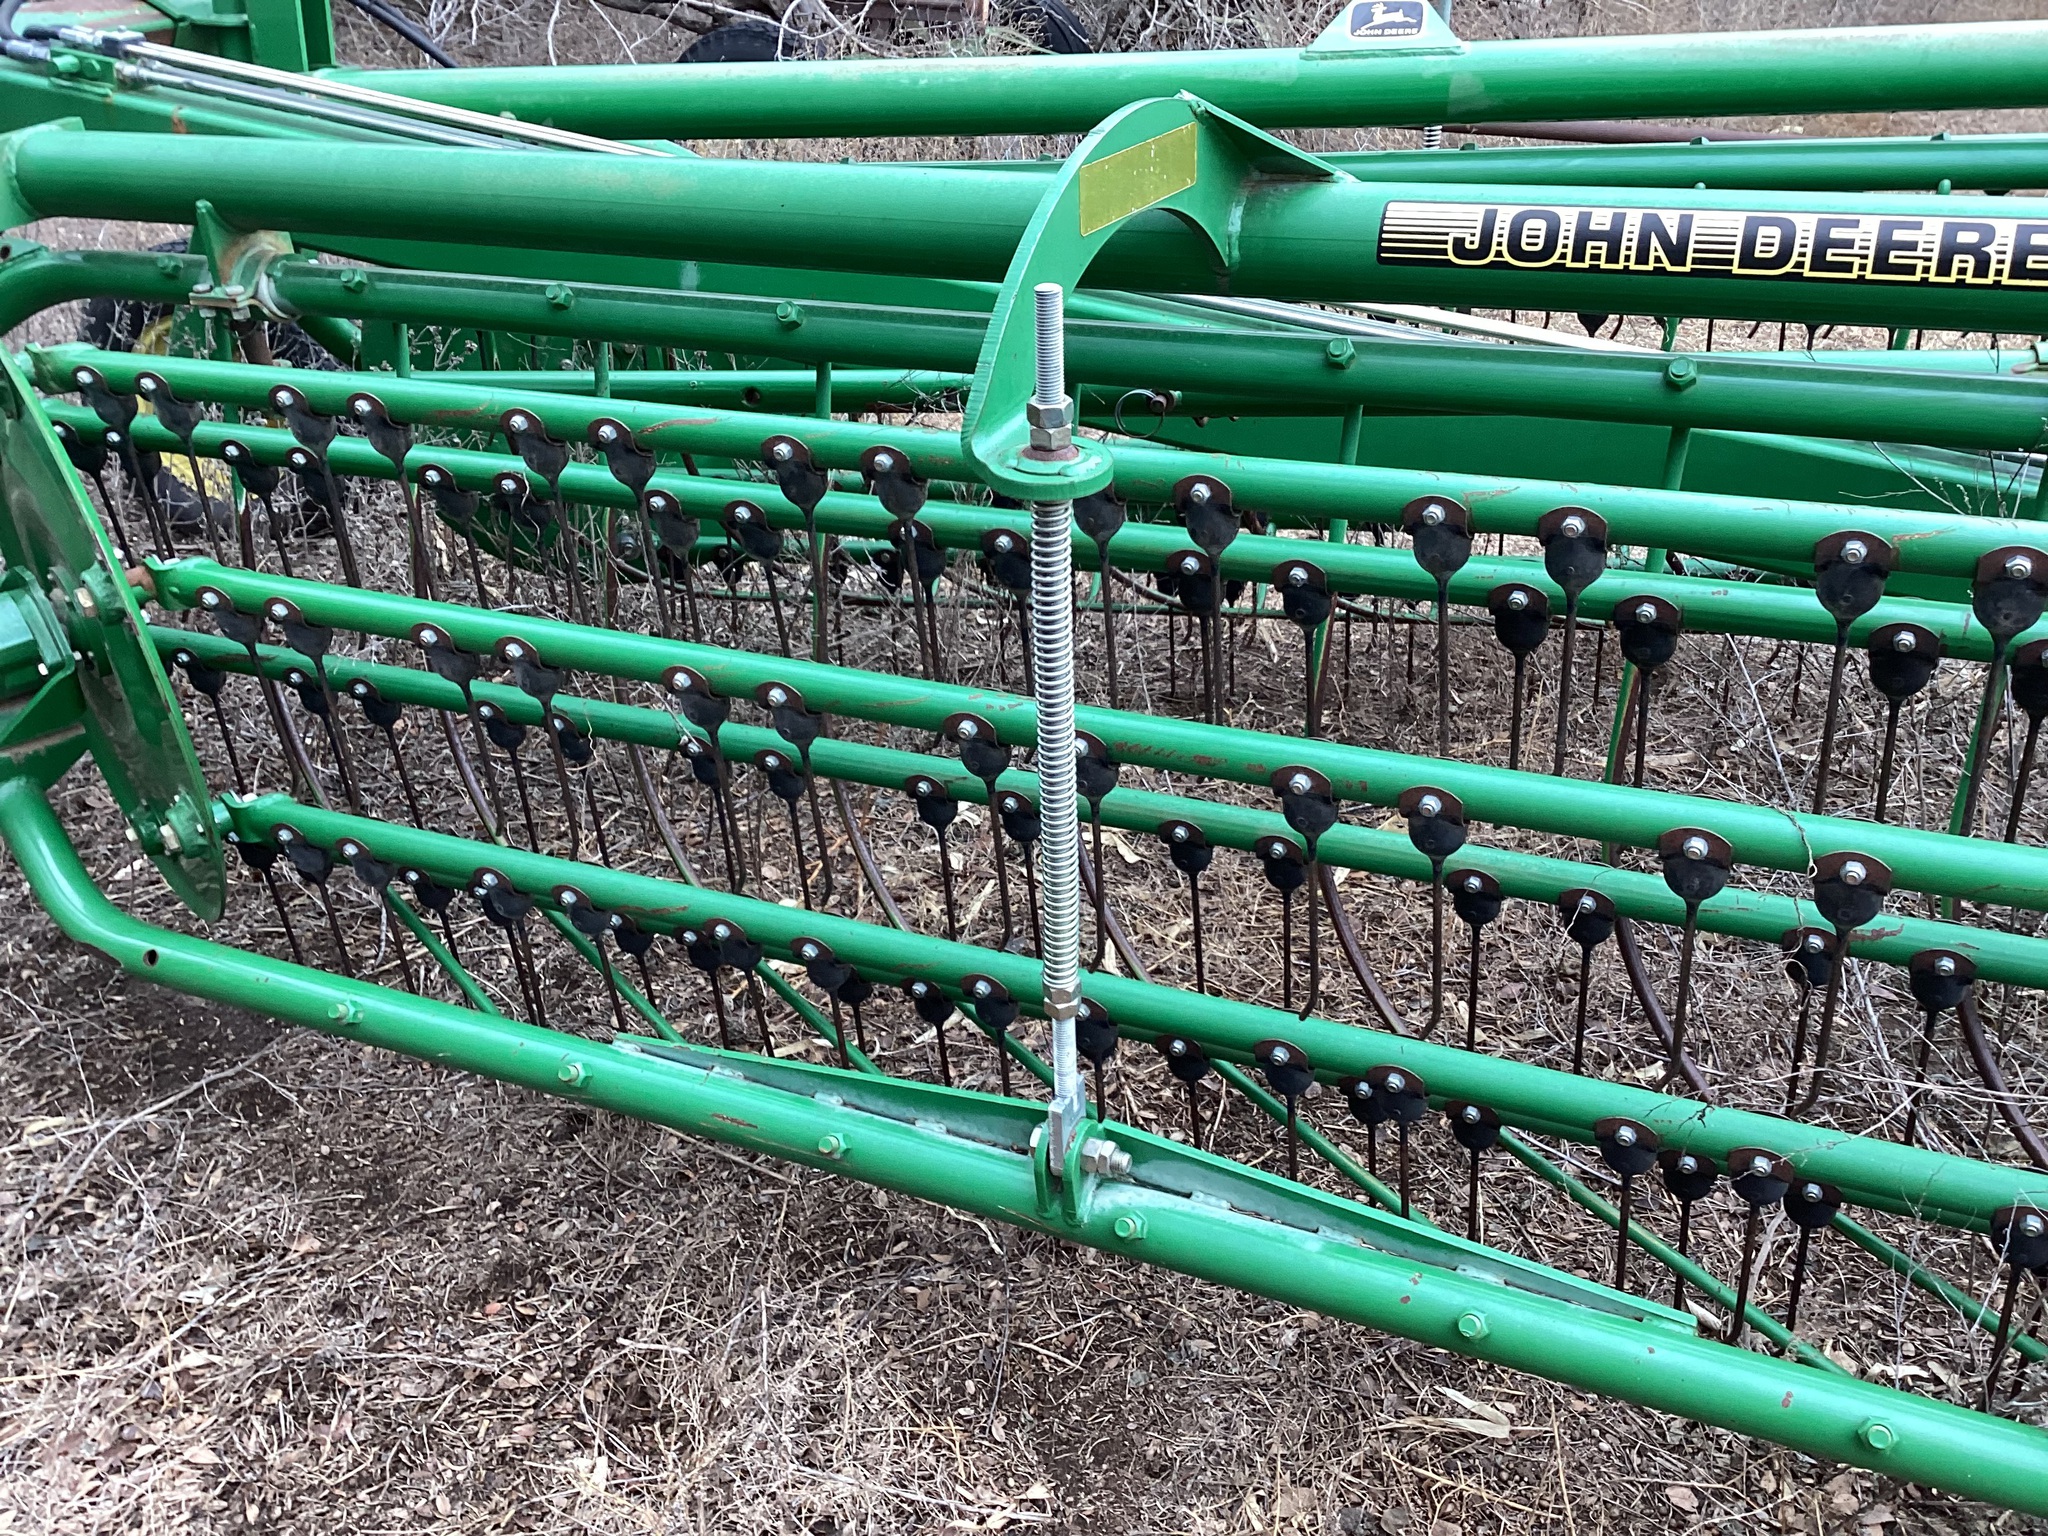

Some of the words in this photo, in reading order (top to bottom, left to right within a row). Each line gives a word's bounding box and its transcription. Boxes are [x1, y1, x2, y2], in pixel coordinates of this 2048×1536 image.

[1353, 28, 1382, 36] JOHN
[1448, 208, 1695, 272] JOHN
[1732, 215, 2048, 285] DEERE
